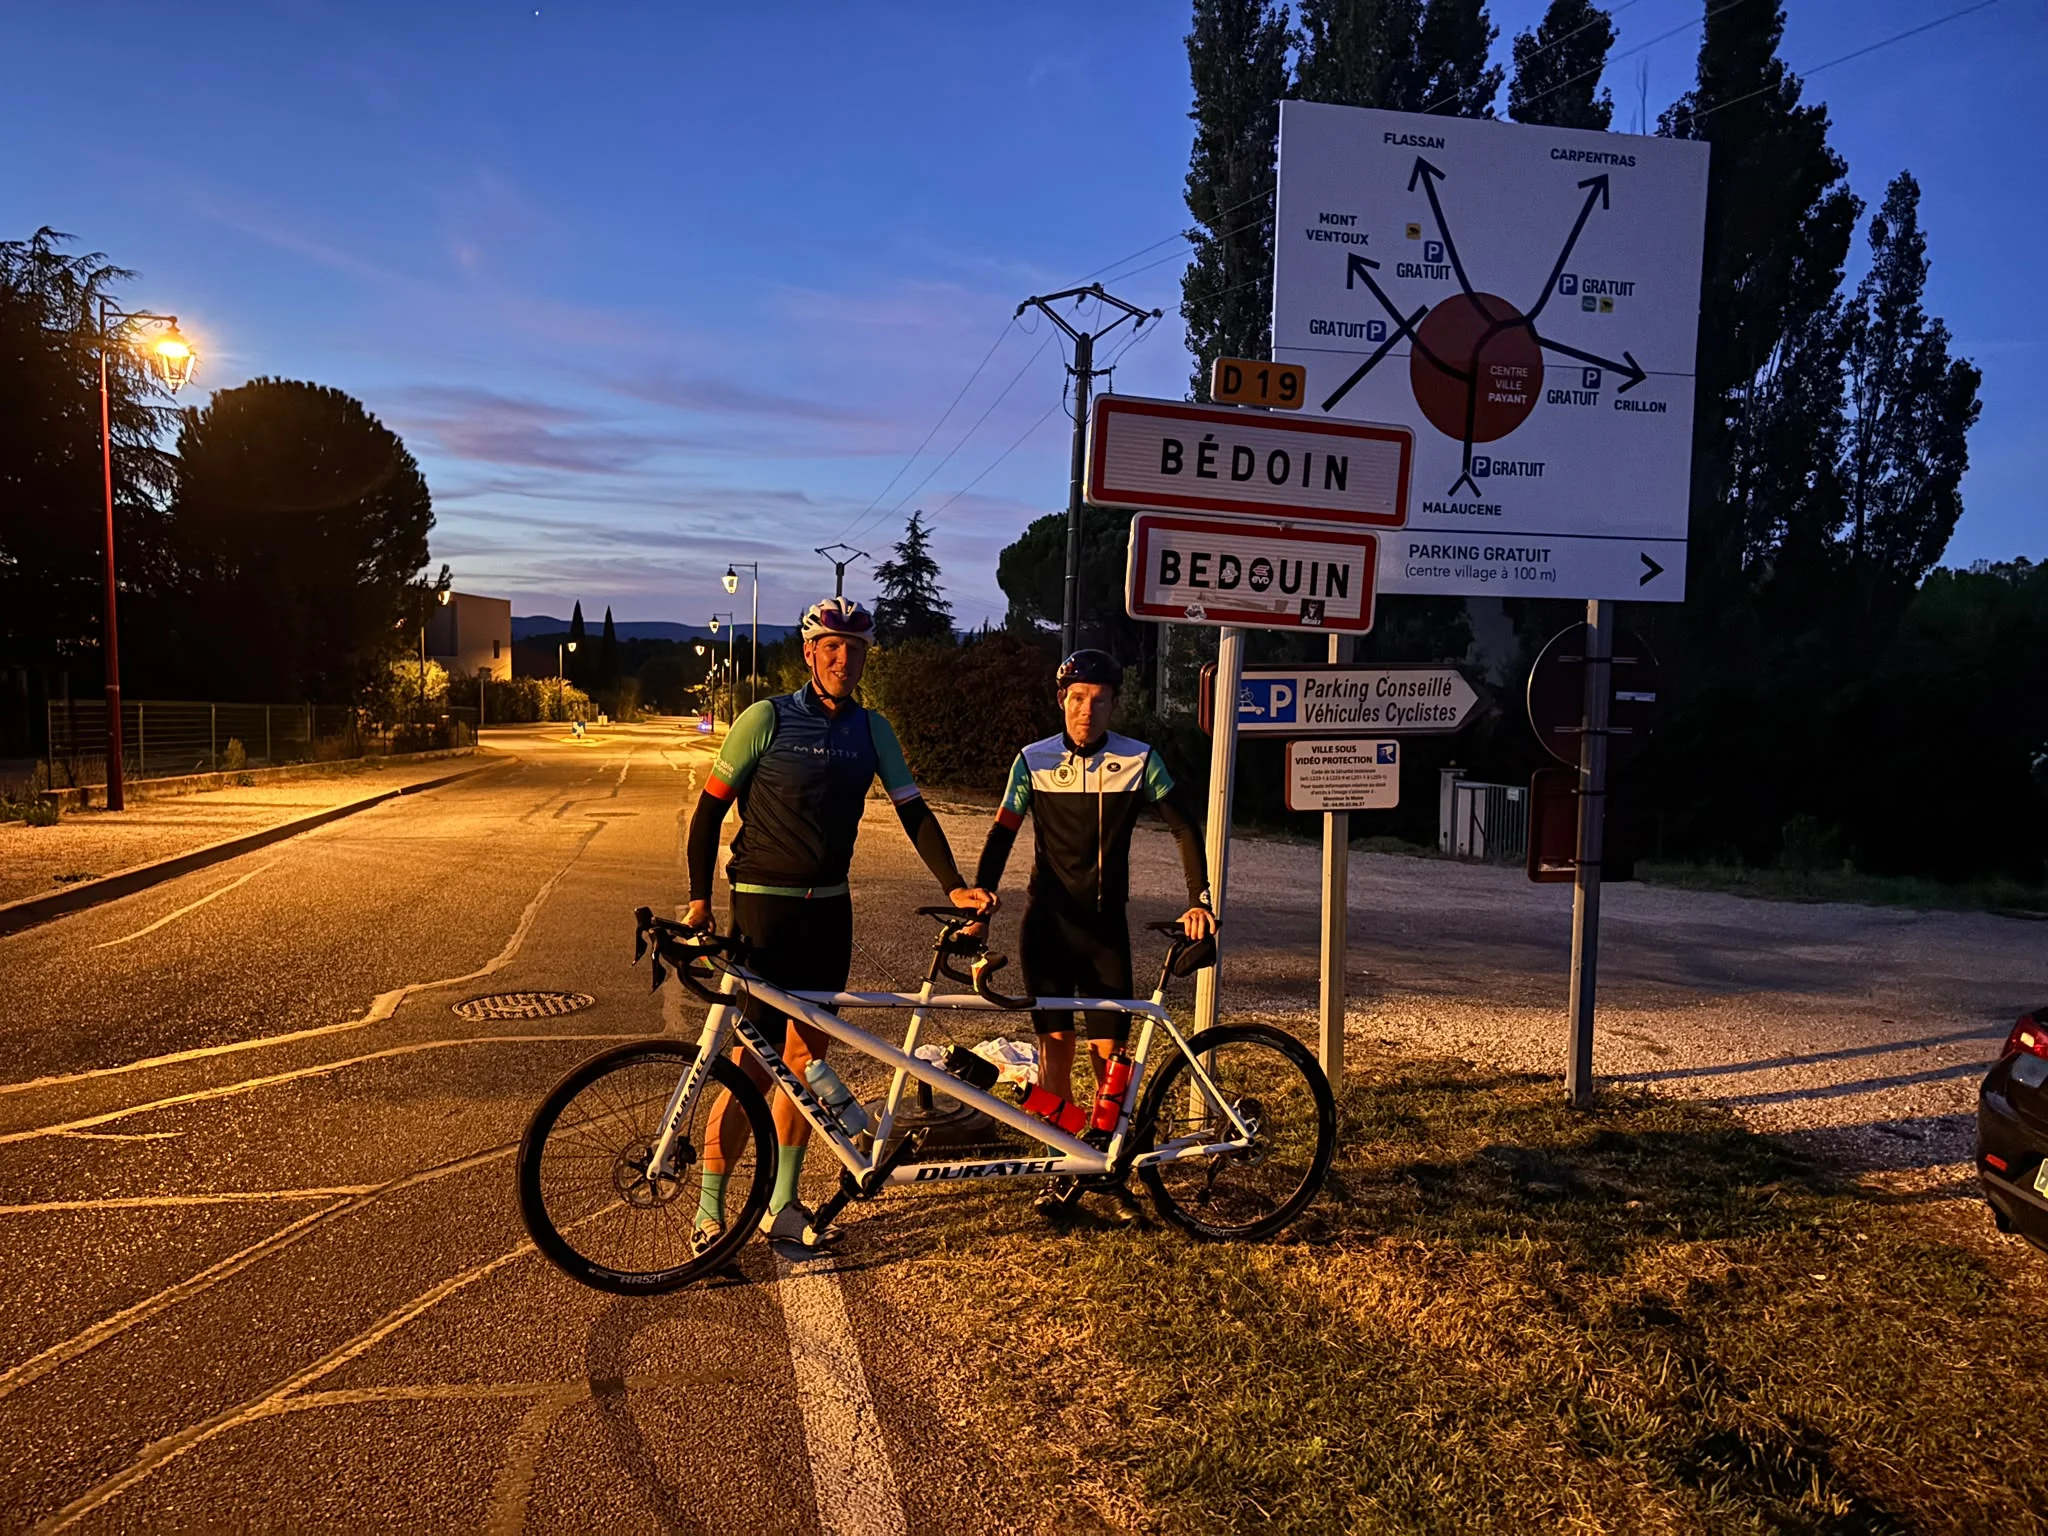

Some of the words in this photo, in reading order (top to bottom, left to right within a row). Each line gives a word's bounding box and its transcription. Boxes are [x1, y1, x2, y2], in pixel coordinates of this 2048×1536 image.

[1384, 132, 1445, 149] FLASSAN
[1550, 148, 1636, 167] CARPENTRAS
[1319, 212, 1357, 227] MONT
[1306, 229, 1369, 246] VENTOUX
[1428, 243, 1440, 260] P
[1396, 262, 1451, 280] GRATUIT
[1562, 276, 1574, 293] P
[1582, 279, 1636, 297] GRATUIT
[1309, 319, 1366, 339] GRATUIT
[1370, 322, 1383, 339] P
[1490, 365, 1528, 378] CENTRE
[1586, 370, 1598, 386] P
[1223, 365, 1242, 394] D
[1256, 369, 1297, 400] 19
[1495, 379, 1522, 391] VILLE
[1488, 393, 1528, 406] PAYANT
[1547, 389, 1599, 406] GRATUIT
[1614, 400, 1667, 414] CRILLON
[1160, 434, 1349, 491] BÉDOIN
[1475, 459, 1488, 475] P
[1492, 460, 1545, 477] GRATUIT
[1422, 502, 1502, 517] MALAUCENE
[1408, 543, 1480, 562] PARKING
[1483, 546, 1551, 563] GRATUIT
[1405, 563, 1451, 580] (centre
[1454, 564, 1498, 582] village
[1501, 565, 1509, 580] à
[1513, 566, 1537, 581] 100
[1539, 567, 1557, 583] m)
[1269, 684, 1293, 718] P
[1304, 678, 1369, 702] Parking
[1376, 676, 1452, 698] Conseillé
[1304, 703, 1380, 723] Véhicules
[1385, 703, 1457, 726] Cyclistes
[1311, 745, 1334, 754] VILLE
[1335, 745, 1357, 753] SOUS
[1295, 756, 1321, 765] VIDÉO
[1321, 756, 1373, 765] PROTECTION
[740, 1018, 841, 1146] DURATEC
[669, 1052, 709, 1131] DURATEC
[914, 1158, 1068, 1182] DURATEC
[619, 1274, 662, 1285] RR521
